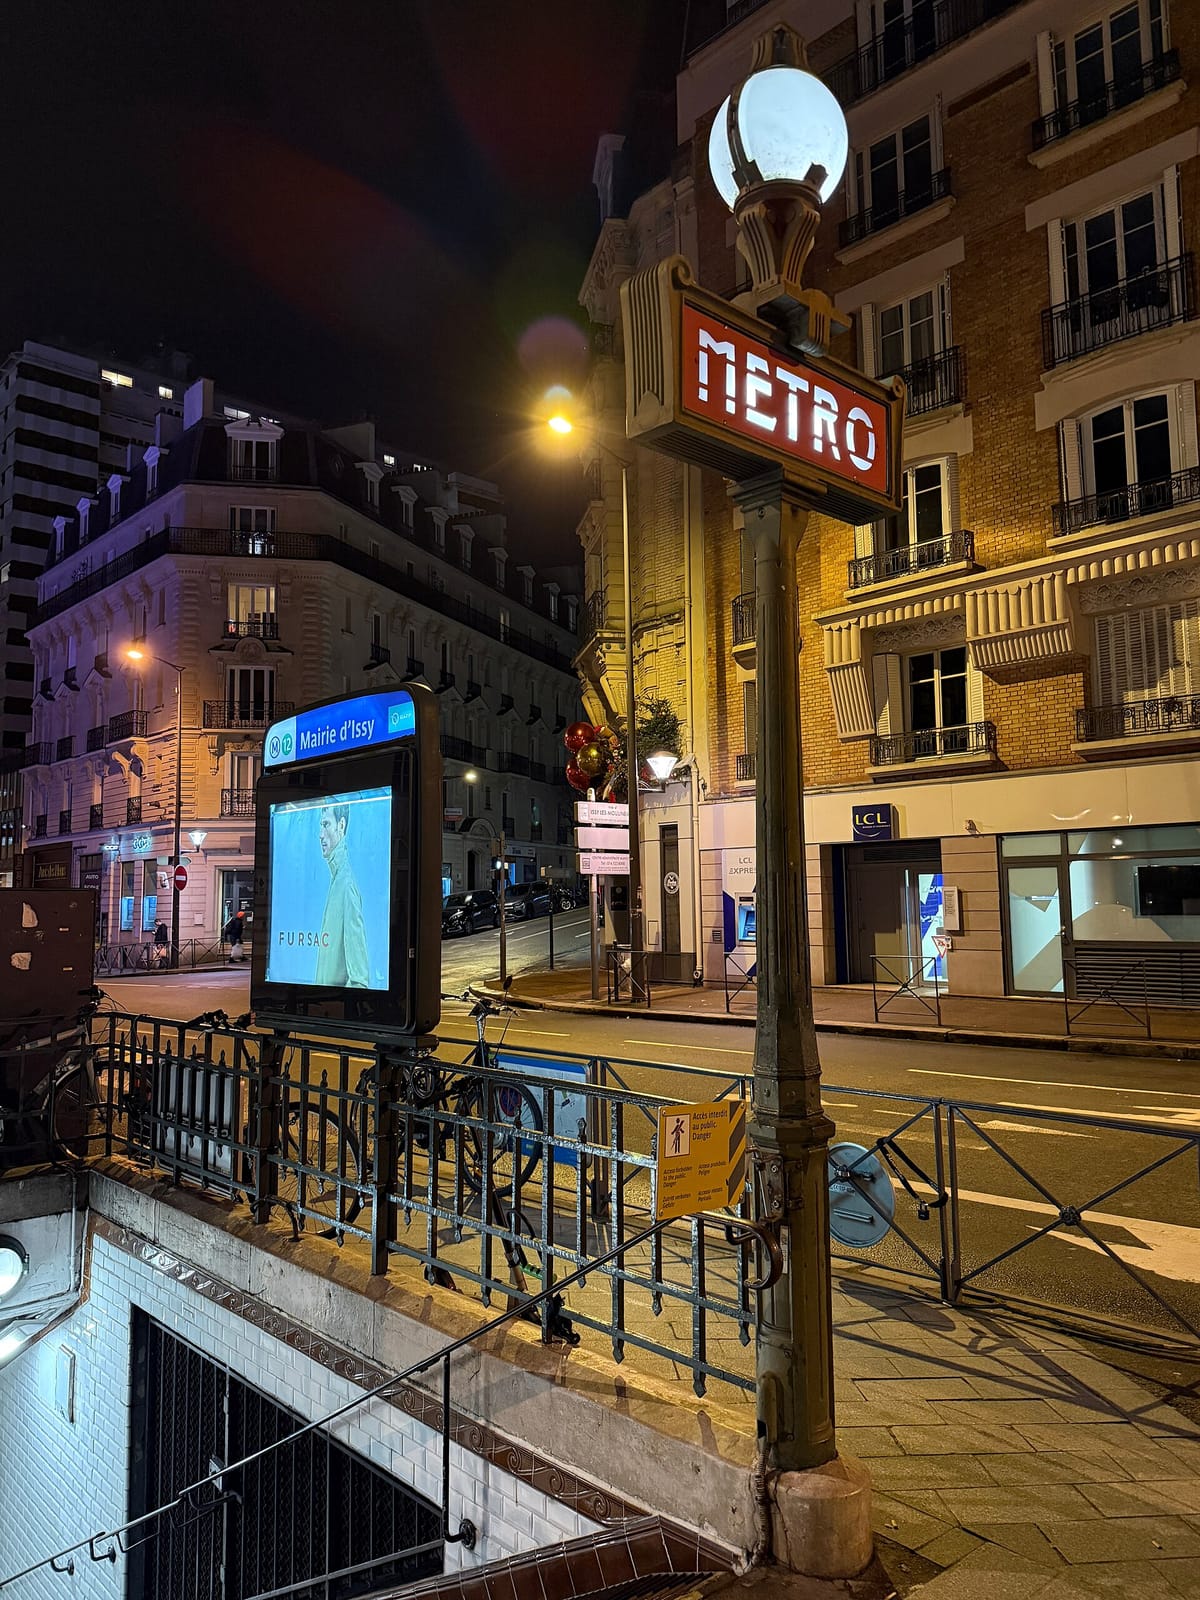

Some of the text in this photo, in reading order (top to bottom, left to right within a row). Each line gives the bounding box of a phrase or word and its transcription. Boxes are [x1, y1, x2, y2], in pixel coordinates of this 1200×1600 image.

[698, 328, 876, 471] METRO
[283, 738, 292, 751] 12
[300, 725, 337, 750] Mairie
[340, 719, 375, 741] d'Issy
[855, 812, 887, 825] LCL
[738, 856, 753, 864] LCL
[279, 931, 329, 948] FURSAC
[692, 1109, 728, 1120] Accès interdit
[692, 1131, 712, 1141] Danger
